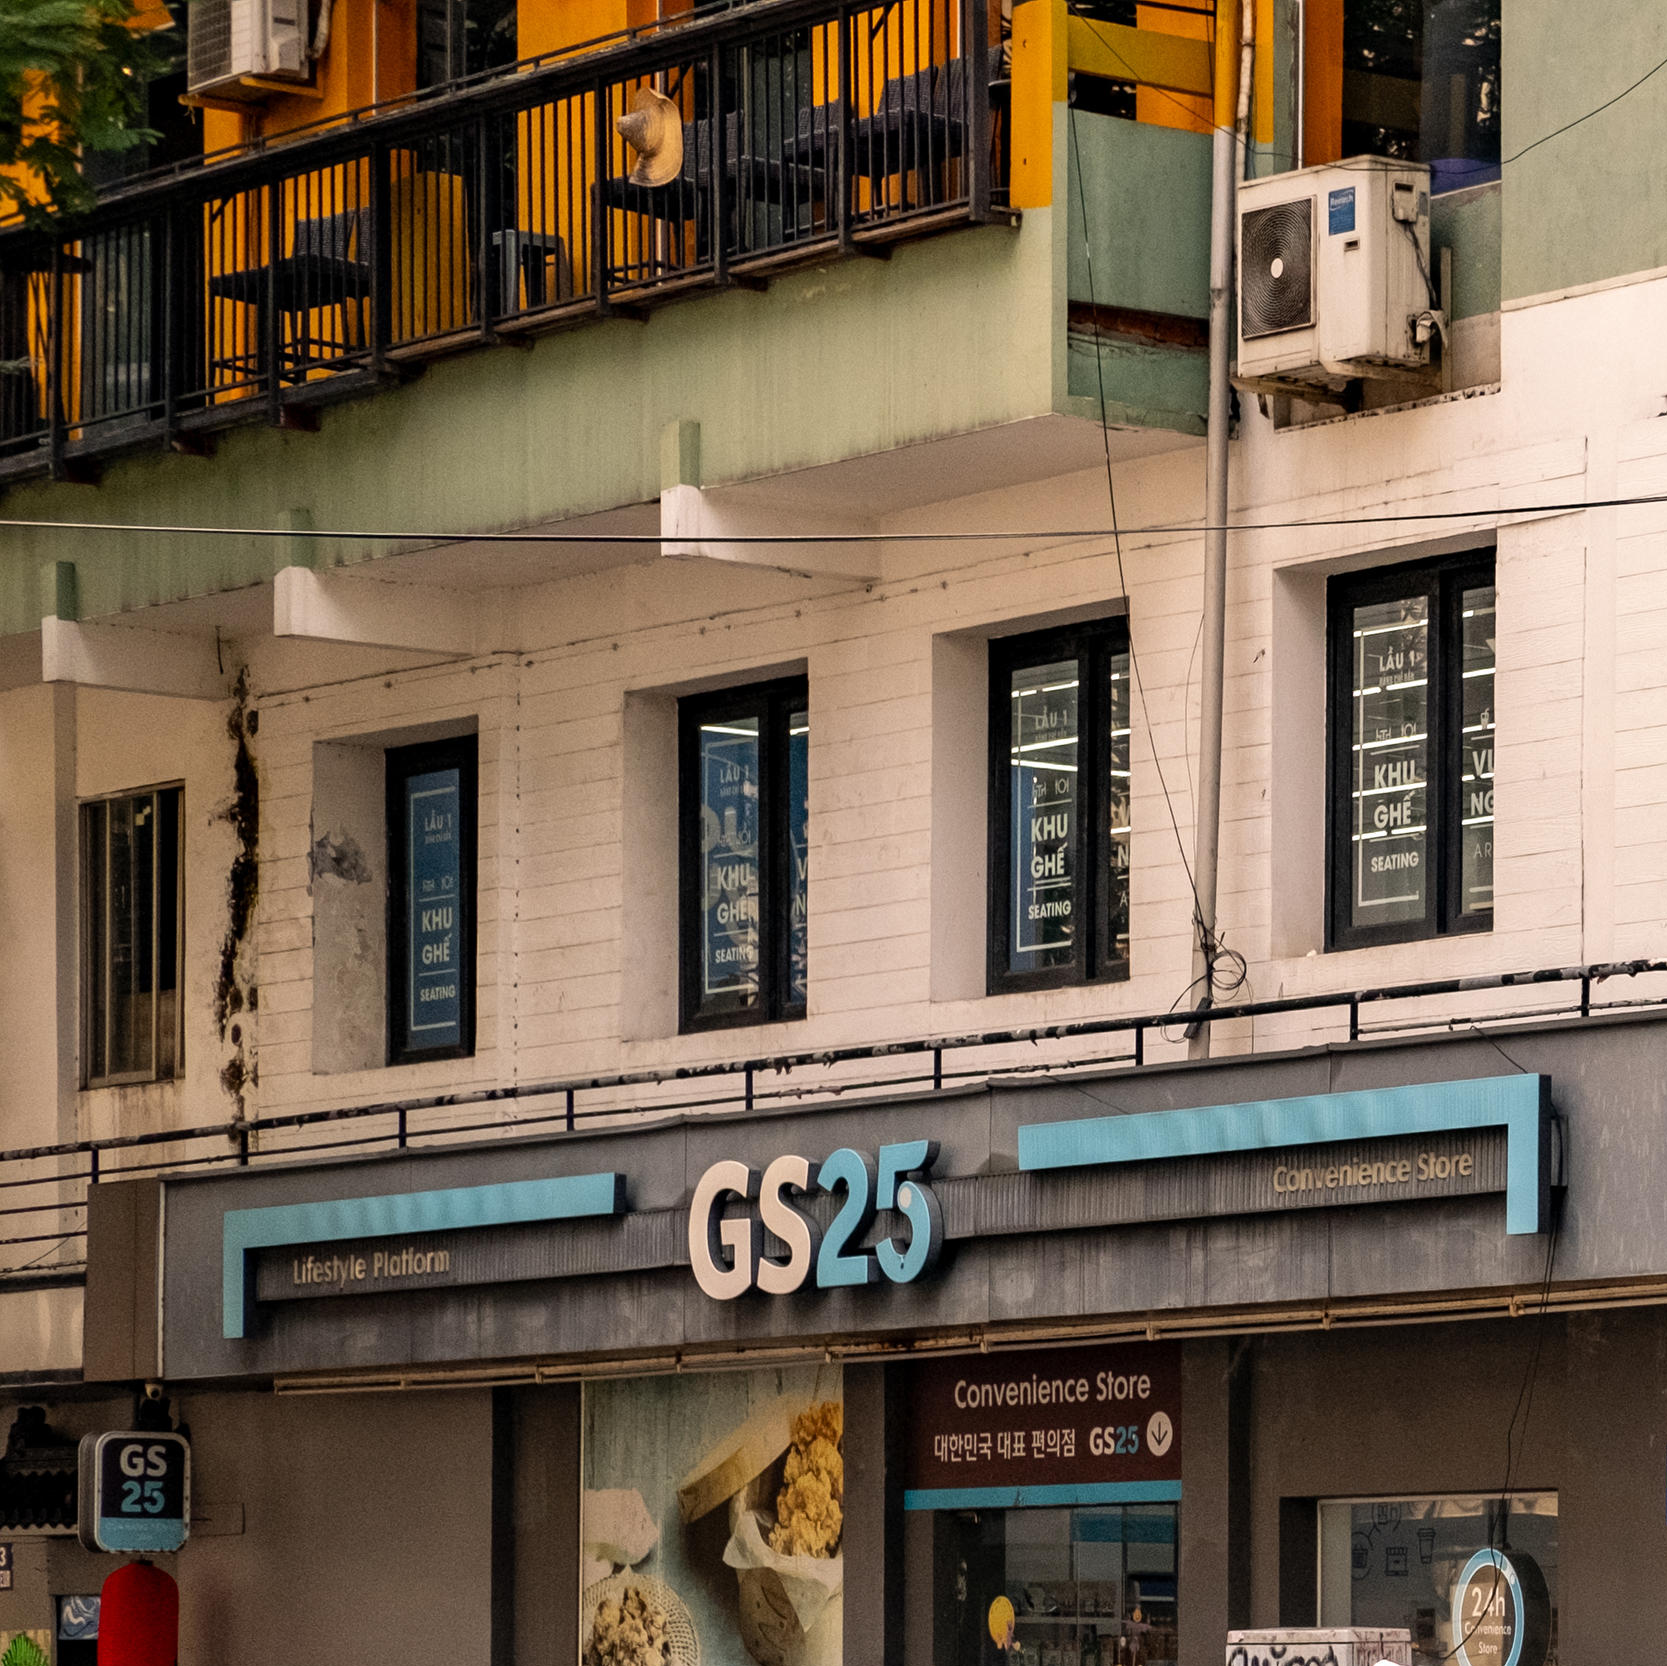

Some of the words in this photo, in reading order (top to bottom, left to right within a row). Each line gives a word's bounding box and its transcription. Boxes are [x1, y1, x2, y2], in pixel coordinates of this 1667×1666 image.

[1374, 759, 1416, 790] KHU
[1373, 790, 1416, 829] GHẾ
[1031, 813, 1069, 842] KHU
[716, 862, 750, 890] KHU
[1030, 842, 1068, 879] GHẾ
[1371, 851, 1419, 873] SEATING
[422, 906, 453, 933] KHU
[1028, 900, 1072, 920] SEATING
[422, 933, 453, 963] GHẾ
[714, 944, 754, 964] SEATING
[420, 983, 456, 1002] SEATING
[1273, 1156, 1411, 1193] Convenience
[1416, 1151, 1473, 1182] Store
[687, 1138, 941, 1302] GS25
[293, 1254, 367, 1289] Lifestyle
[373, 1247, 450, 1278] Platform
[954, 1373, 1089, 1409] Convenience
[1095, 1370, 1151, 1400] Store
[933, 1431, 993, 1463] 대한민국
[997, 1430, 1027, 1461] 대표
[1031, 1427, 1076, 1459] 편의점
[1089, 1425, 1140, 1457] GS25
[119, 1443, 168, 1478] GS
[120, 1480, 166, 1514] 25
[1471, 1586, 1506, 1617] 24h
[1464, 1621, 1512, 1635] Convenience
[1478, 1641, 1498, 1654] Store
